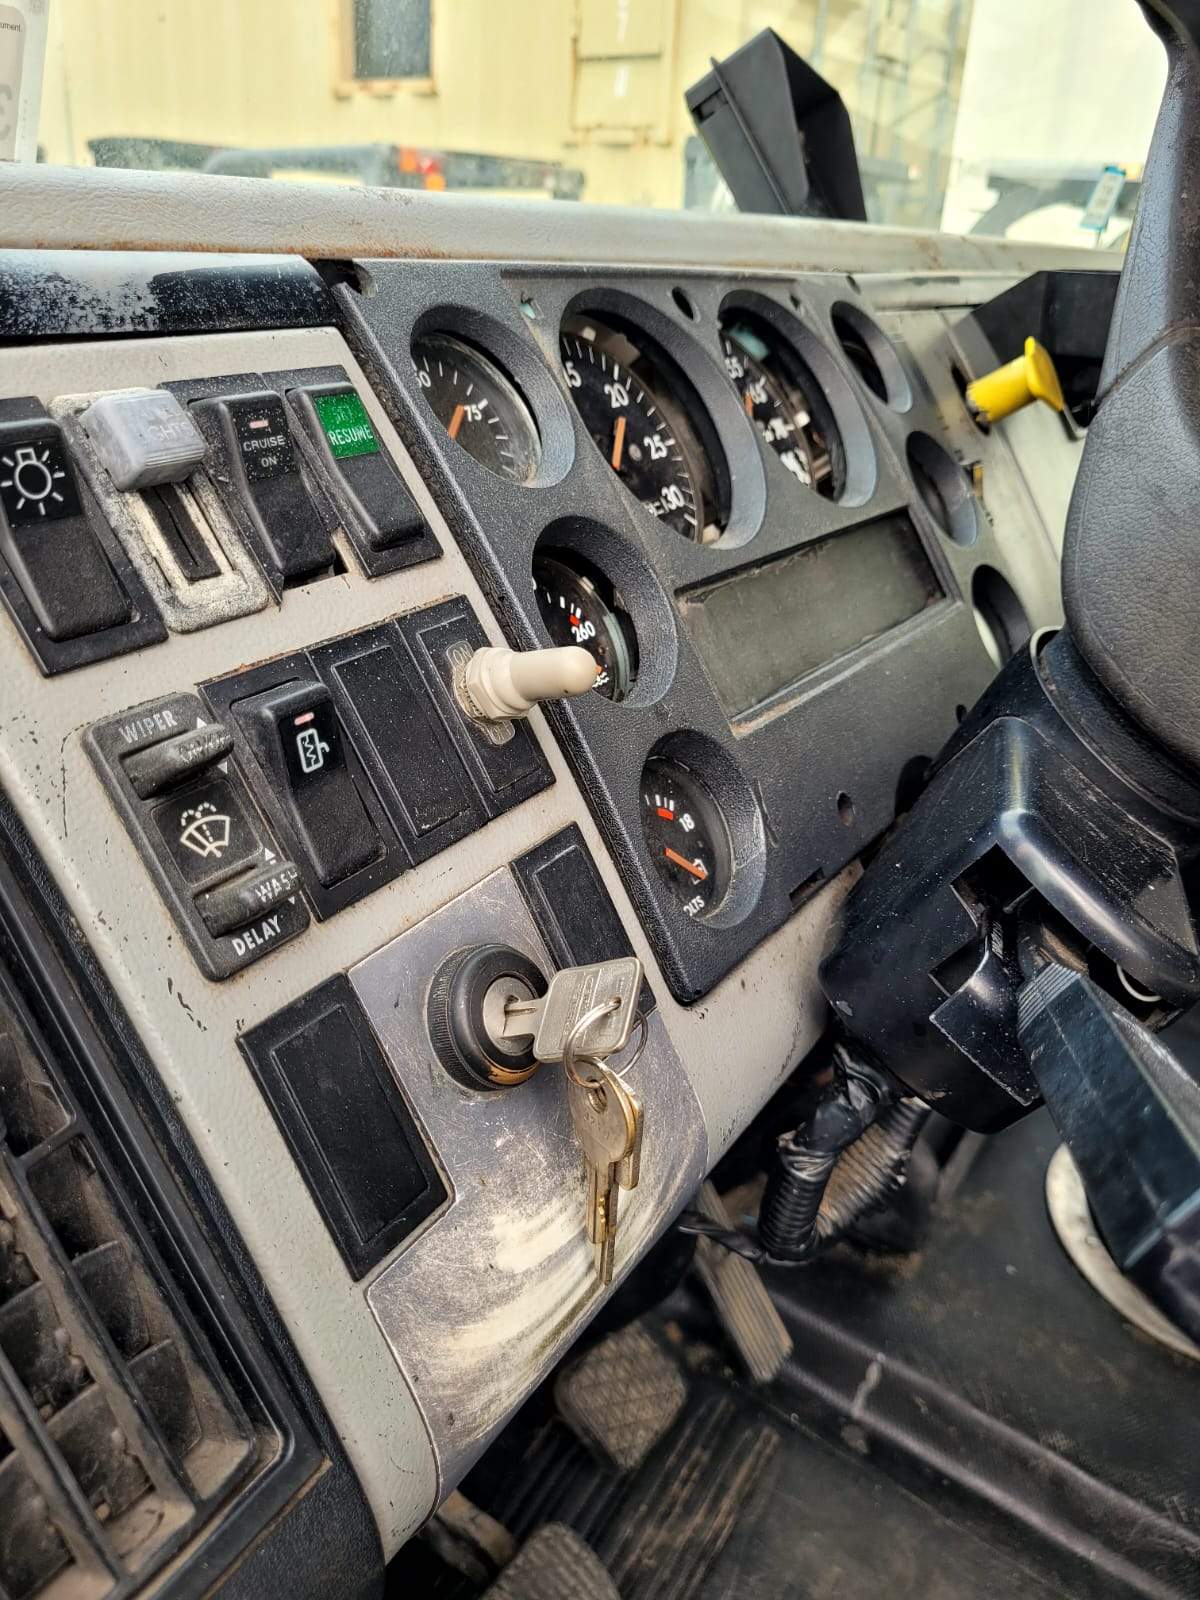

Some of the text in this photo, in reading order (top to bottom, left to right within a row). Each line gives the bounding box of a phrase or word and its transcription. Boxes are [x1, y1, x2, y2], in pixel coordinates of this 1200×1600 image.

[604, 382, 629, 408] 20
[463, 404, 482, 422] 75
[243, 434, 286, 452] CRUISE
[327, 423, 374, 446] RESUME
[643, 435, 668, 460] 25
[260, 455, 278, 468] ON
[661, 484, 685, 510] 30
[571, 621, 596, 643] 260
[118, 710, 178, 744] WIPER
[679, 813, 695, 832] 18
[683, 895, 705, 917] OLTS
[231, 914, 281, 957] DELAY
